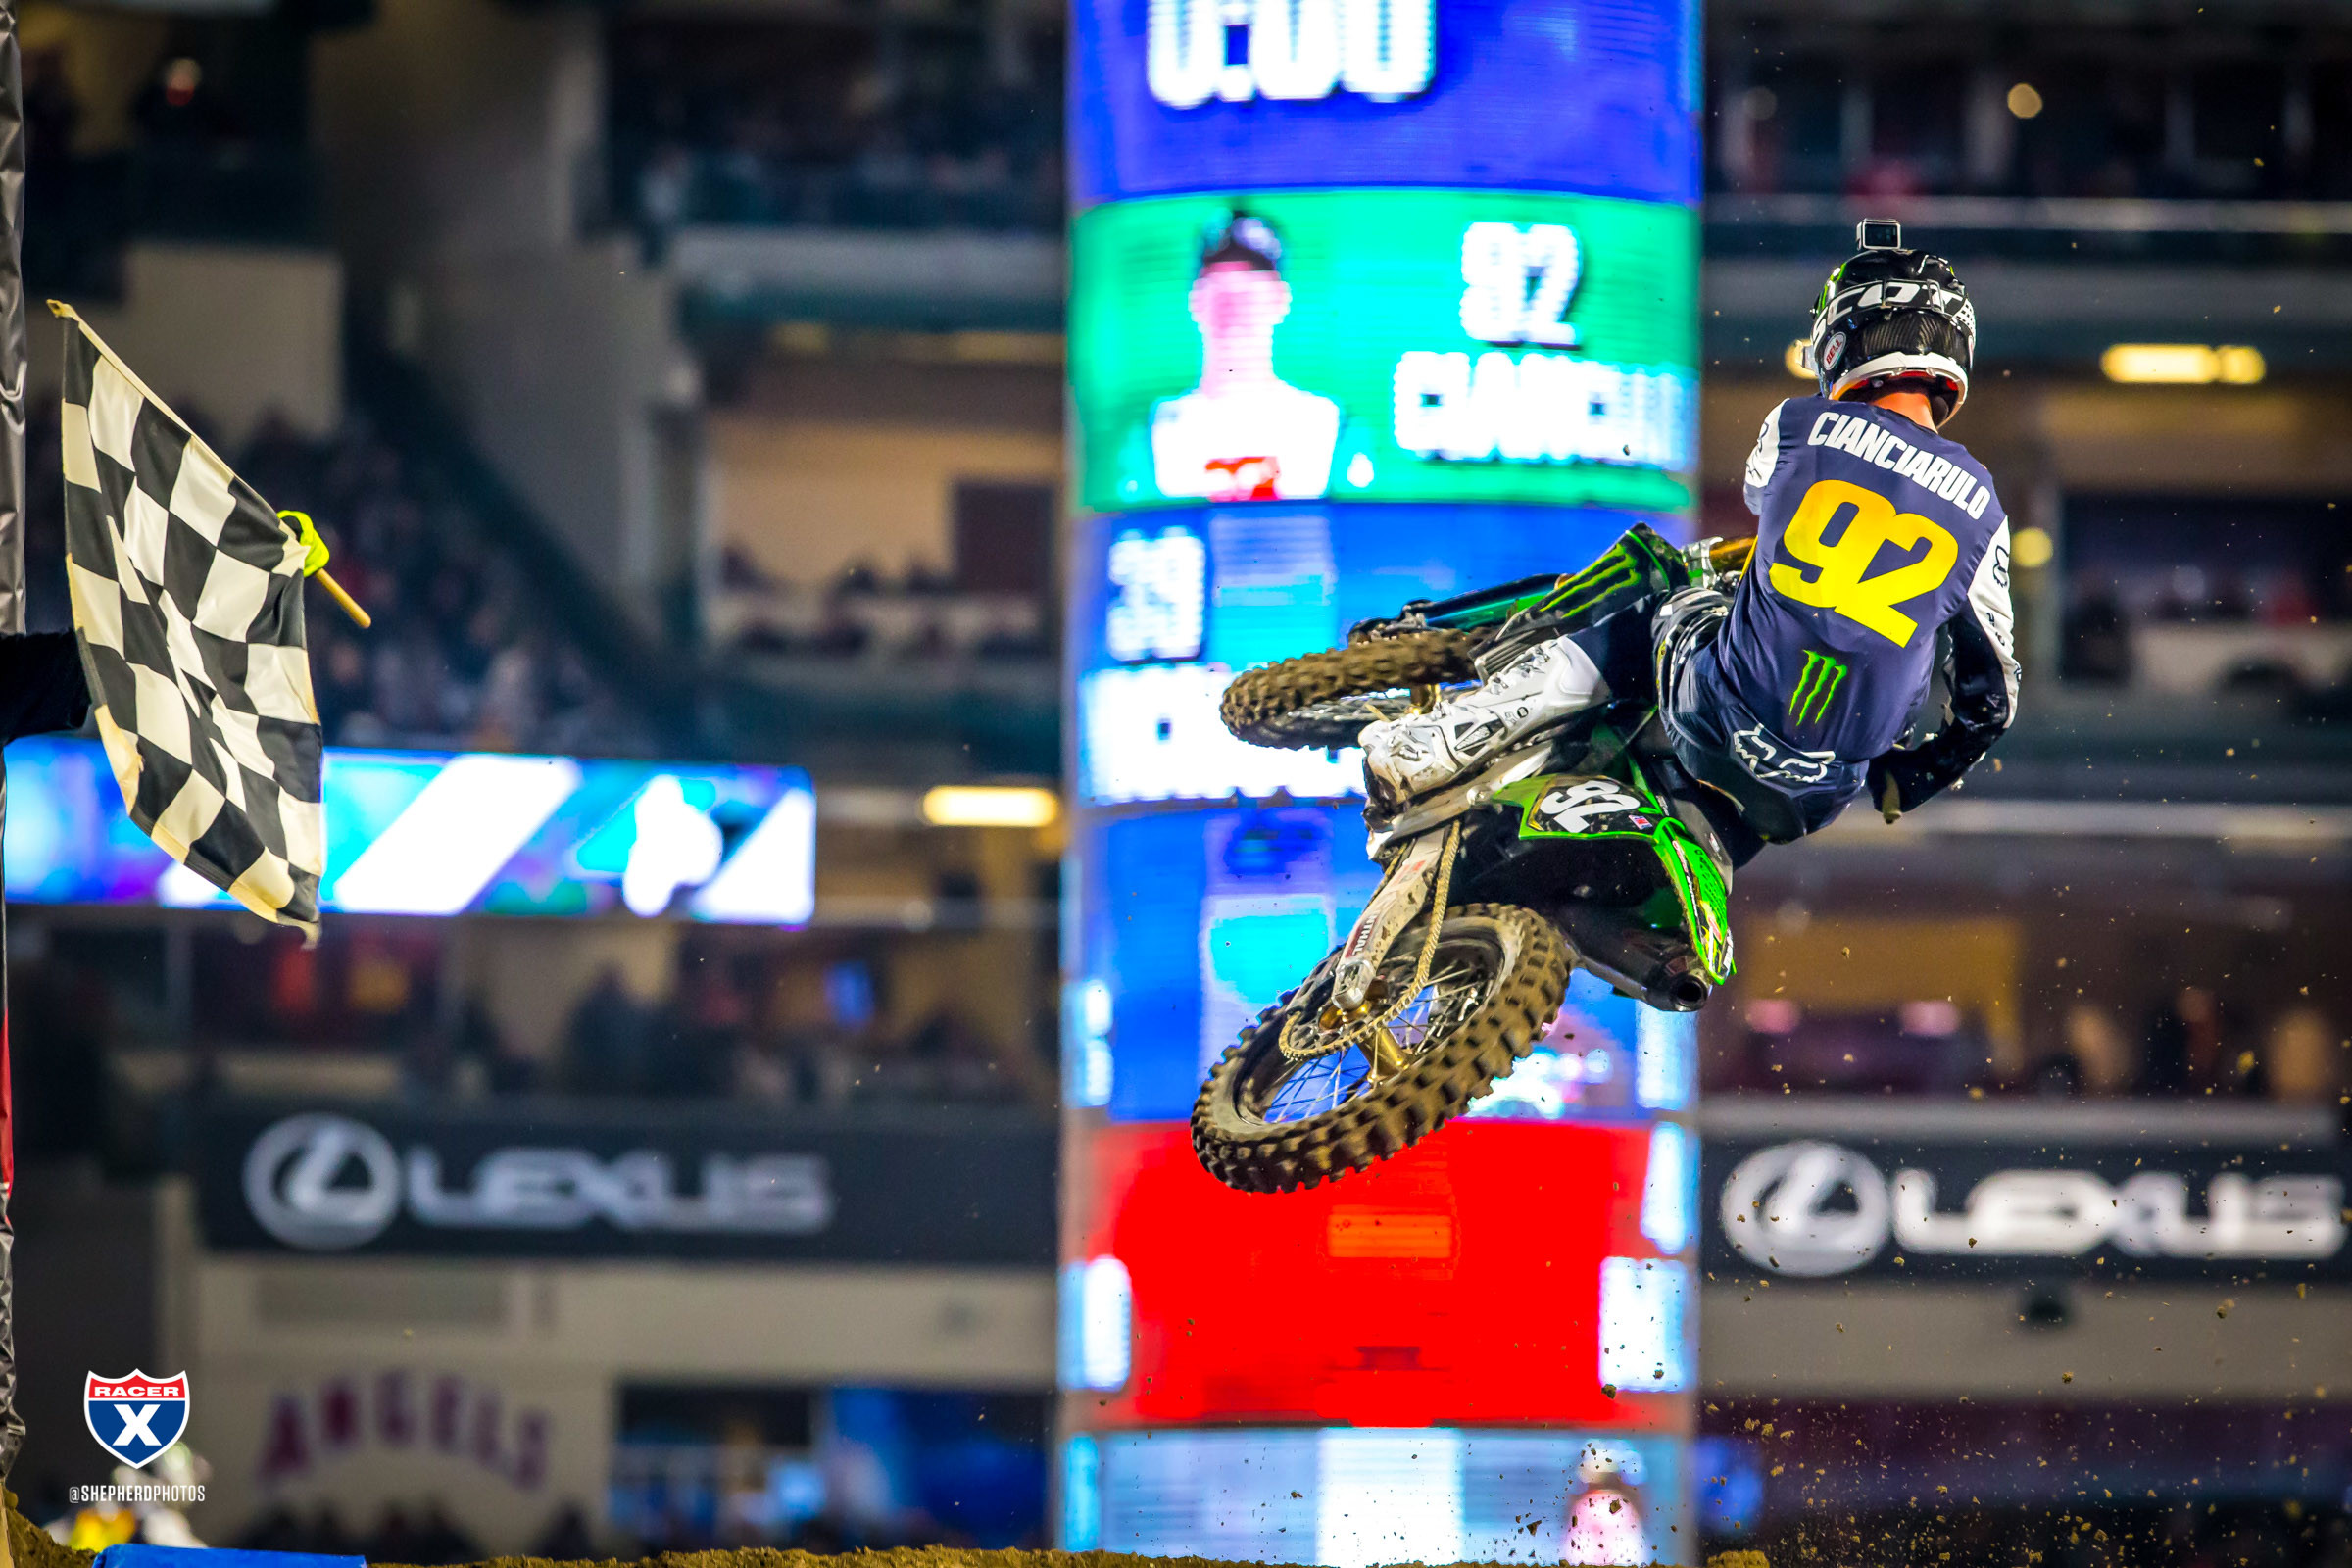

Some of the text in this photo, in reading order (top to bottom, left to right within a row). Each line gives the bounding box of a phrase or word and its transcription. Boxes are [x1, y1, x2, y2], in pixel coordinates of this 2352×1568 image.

[1827, 338, 1842, 365] BELL
[1807, 412, 1990, 520] CIANCIARULO
[1768, 479, 1958, 648] 92
[1540, 780, 1641, 833] 92
[407, 1146, 831, 1233] LEXUS
[1893, 1169, 2345, 1259] LEXUS
